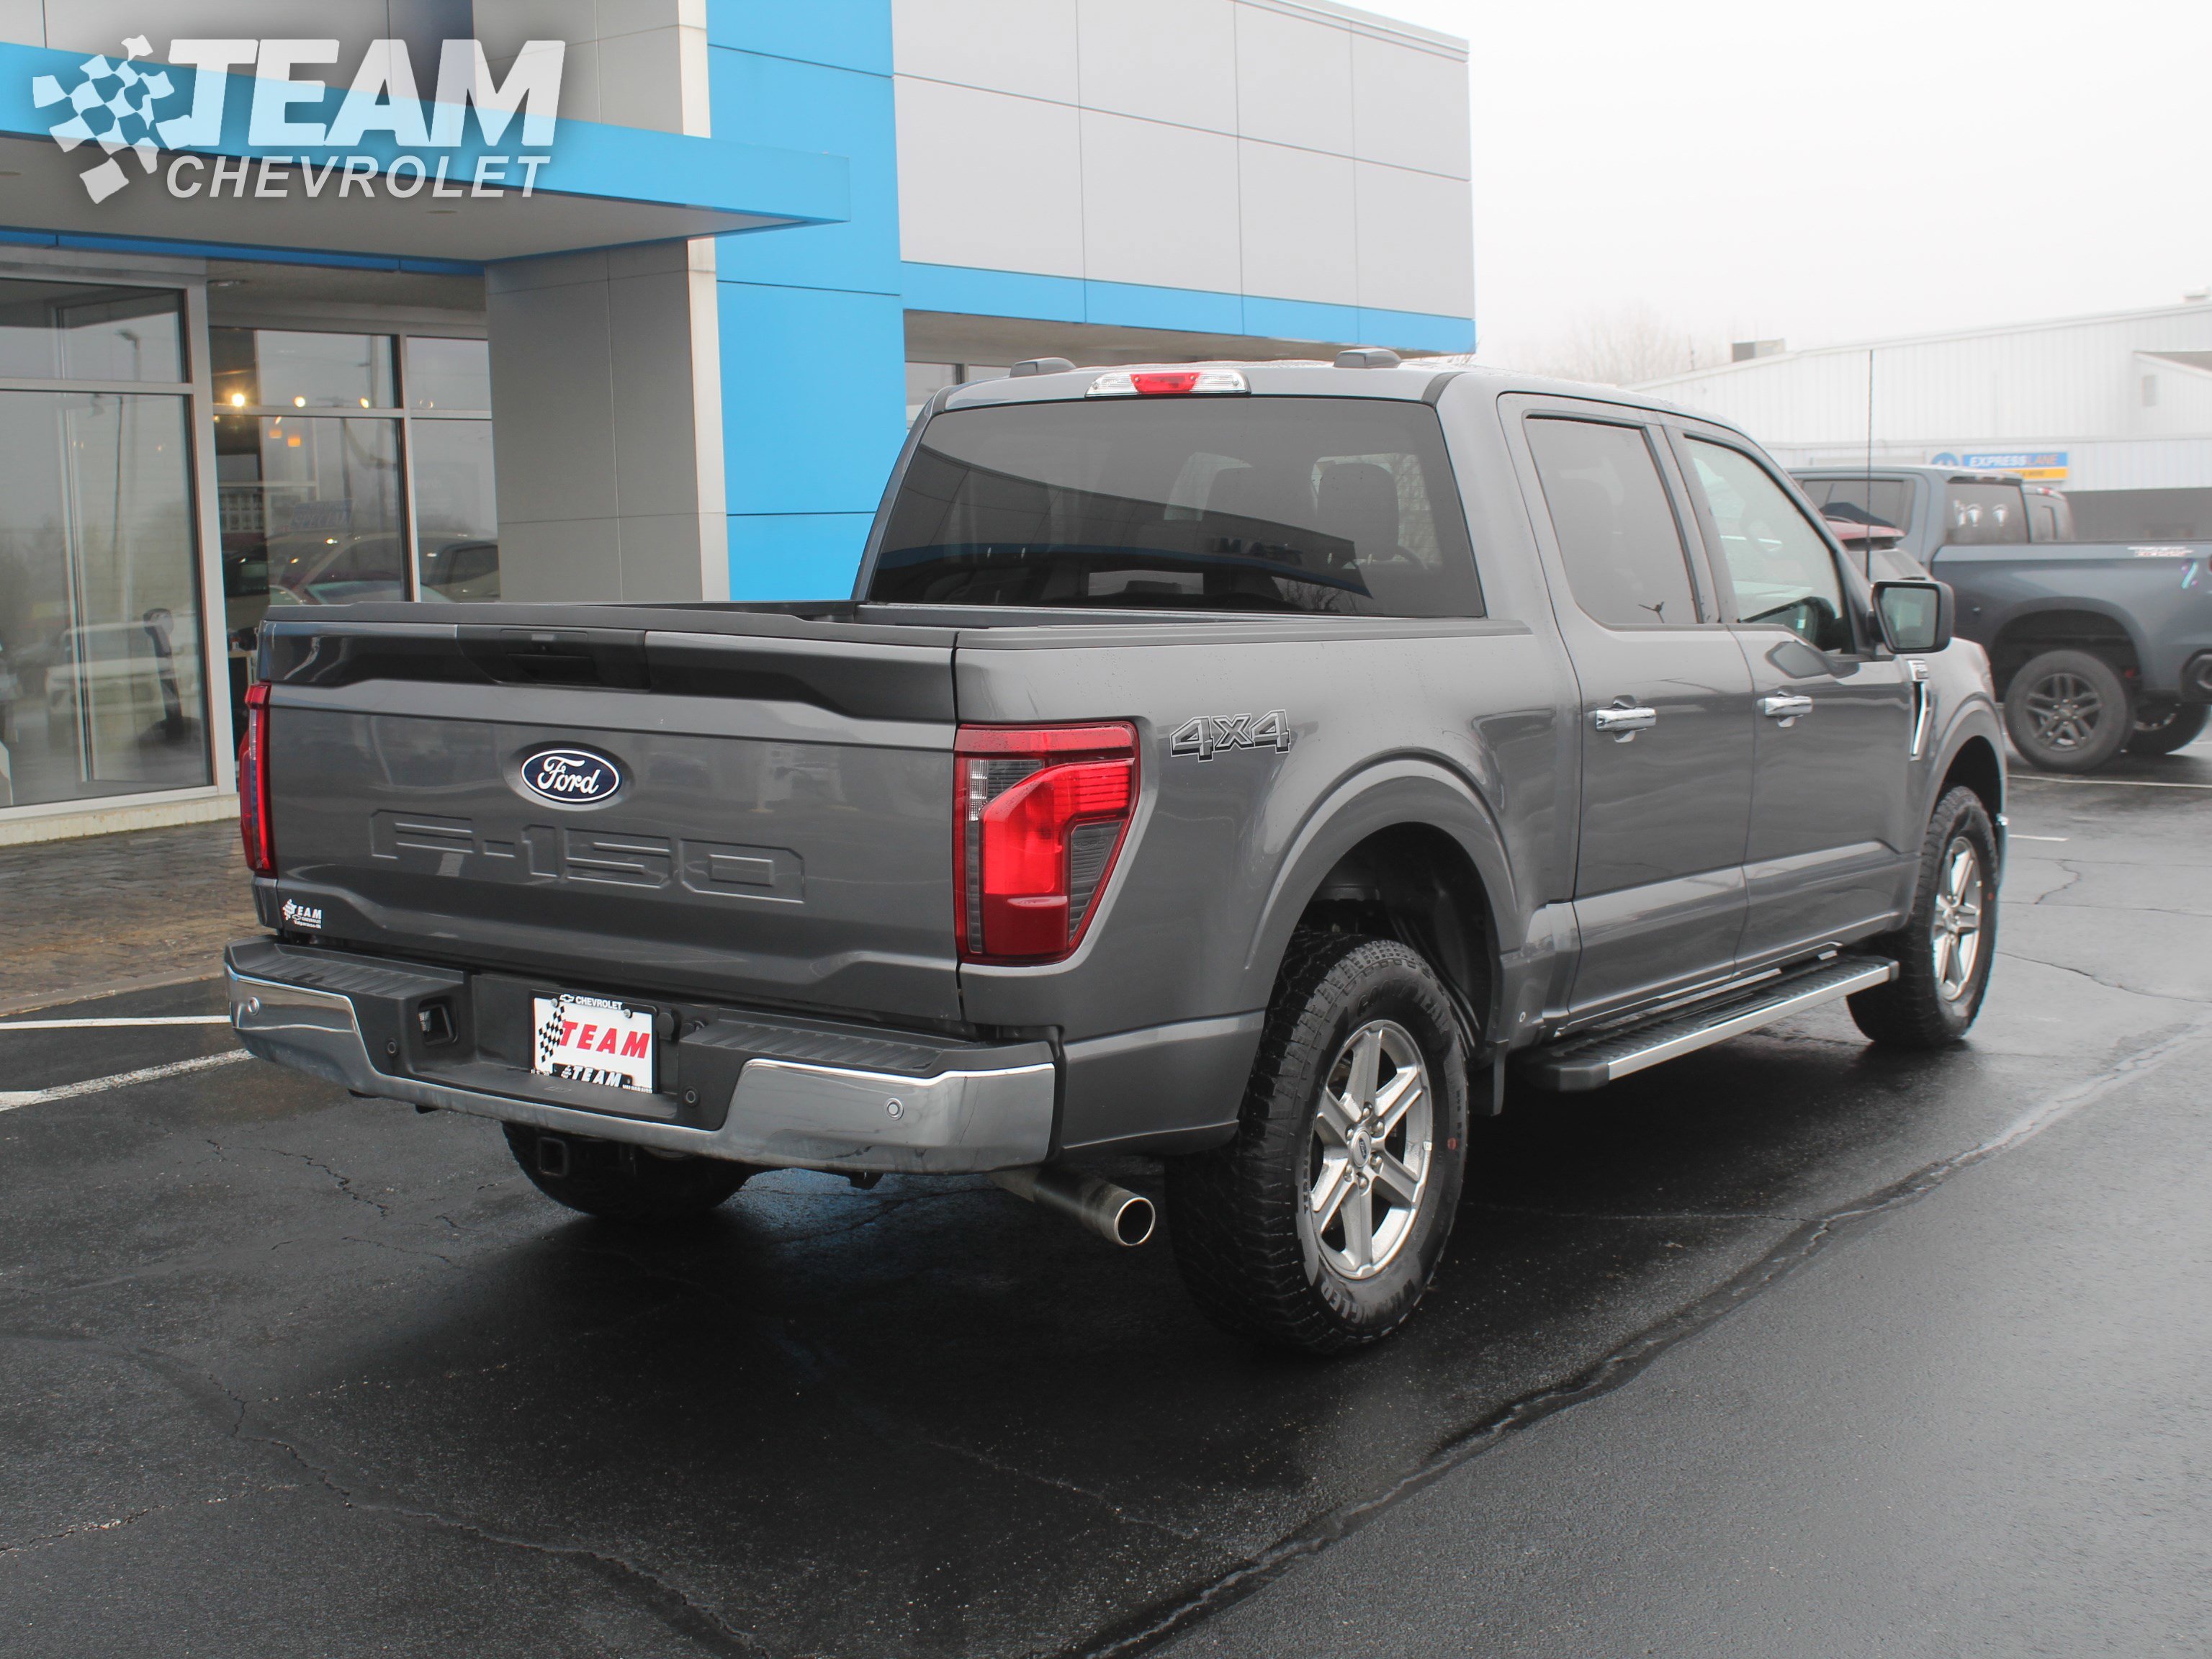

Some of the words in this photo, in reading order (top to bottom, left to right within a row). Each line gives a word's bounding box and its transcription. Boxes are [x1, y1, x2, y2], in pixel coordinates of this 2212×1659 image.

[1969, 455, 2026, 467] EXPRESS
[537, 756, 601, 794] Ford
[370, 809, 806, 904] F-150
[290, 904, 322, 920] TEAM
[575, 995, 623, 1010] CHEVROLET
[558, 1020, 650, 1058] TEAM
[571, 1065, 622, 1088] TEAM
